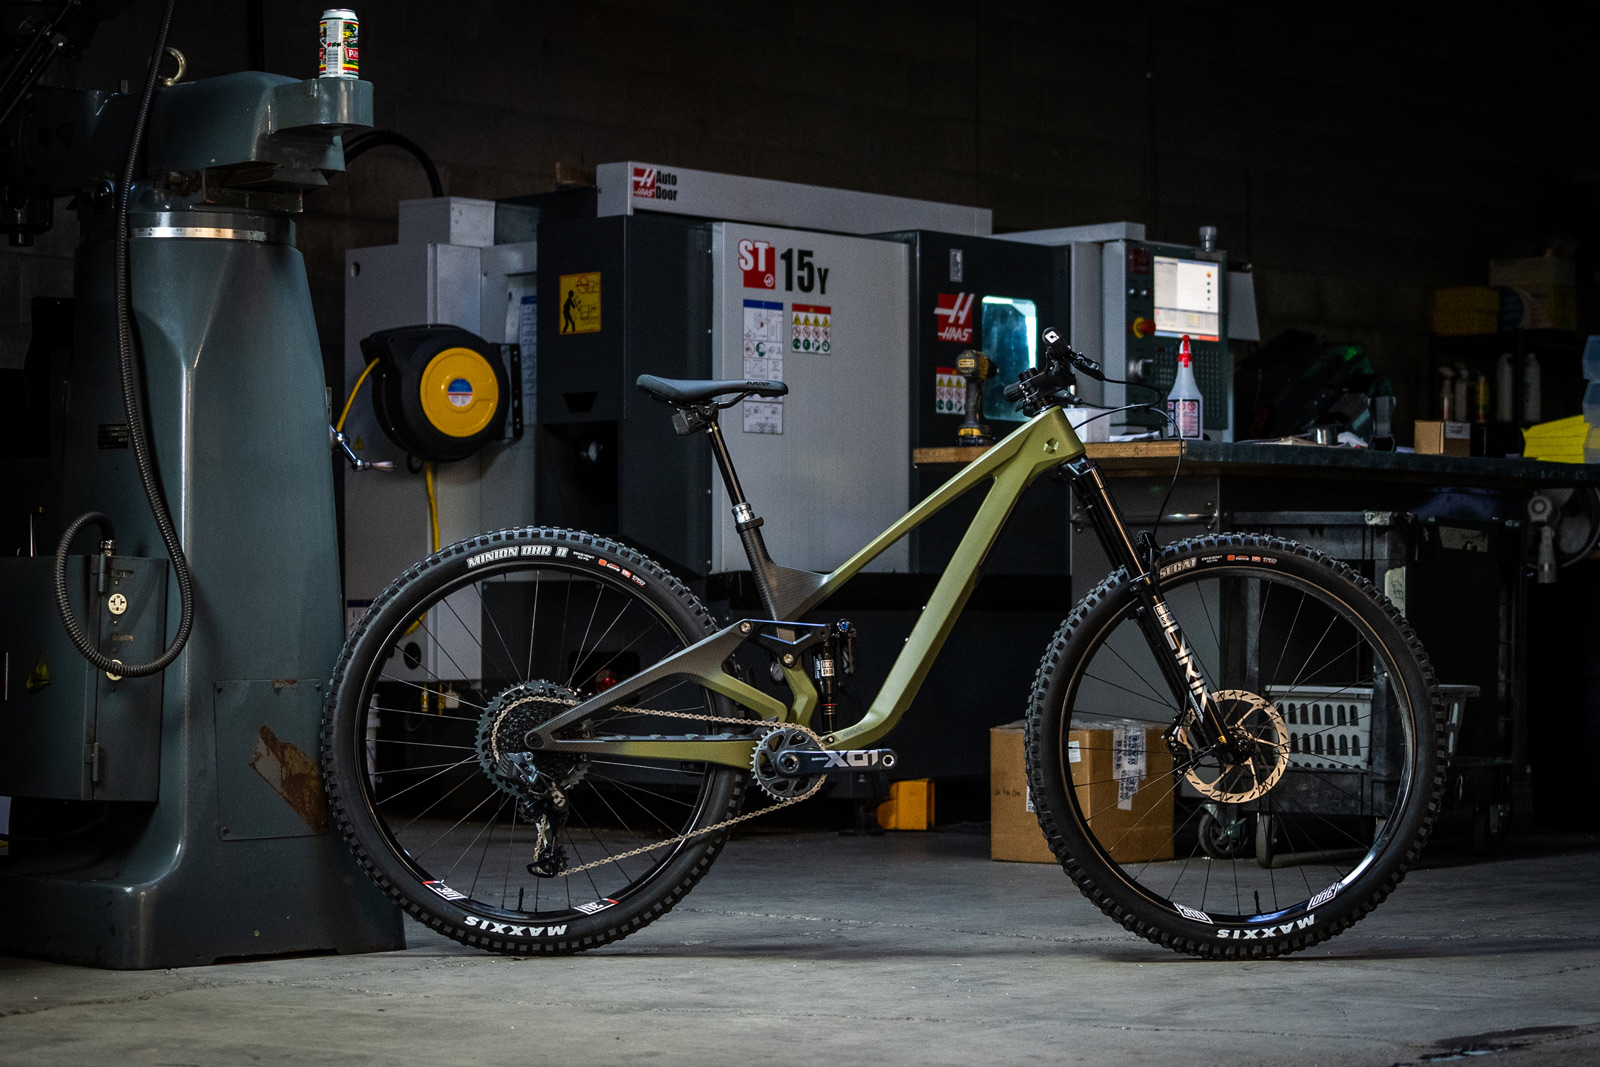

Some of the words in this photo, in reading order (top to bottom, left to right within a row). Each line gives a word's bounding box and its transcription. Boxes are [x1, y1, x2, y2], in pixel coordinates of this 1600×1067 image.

[656, 171, 677, 186] Auto
[656, 186, 678, 201] Door
[738, 239, 770, 272] ST
[937, 326, 973, 342] HAAS
[466, 546, 519, 569] MINION
[520, 545, 553, 557] DHR
[1159, 557, 1198, 579] SEGAI
[1164, 622, 1213, 713] LYRIK
[463, 915, 568, 937] MAXXIS
[1216, 914, 1315, 940] MAXXIS
